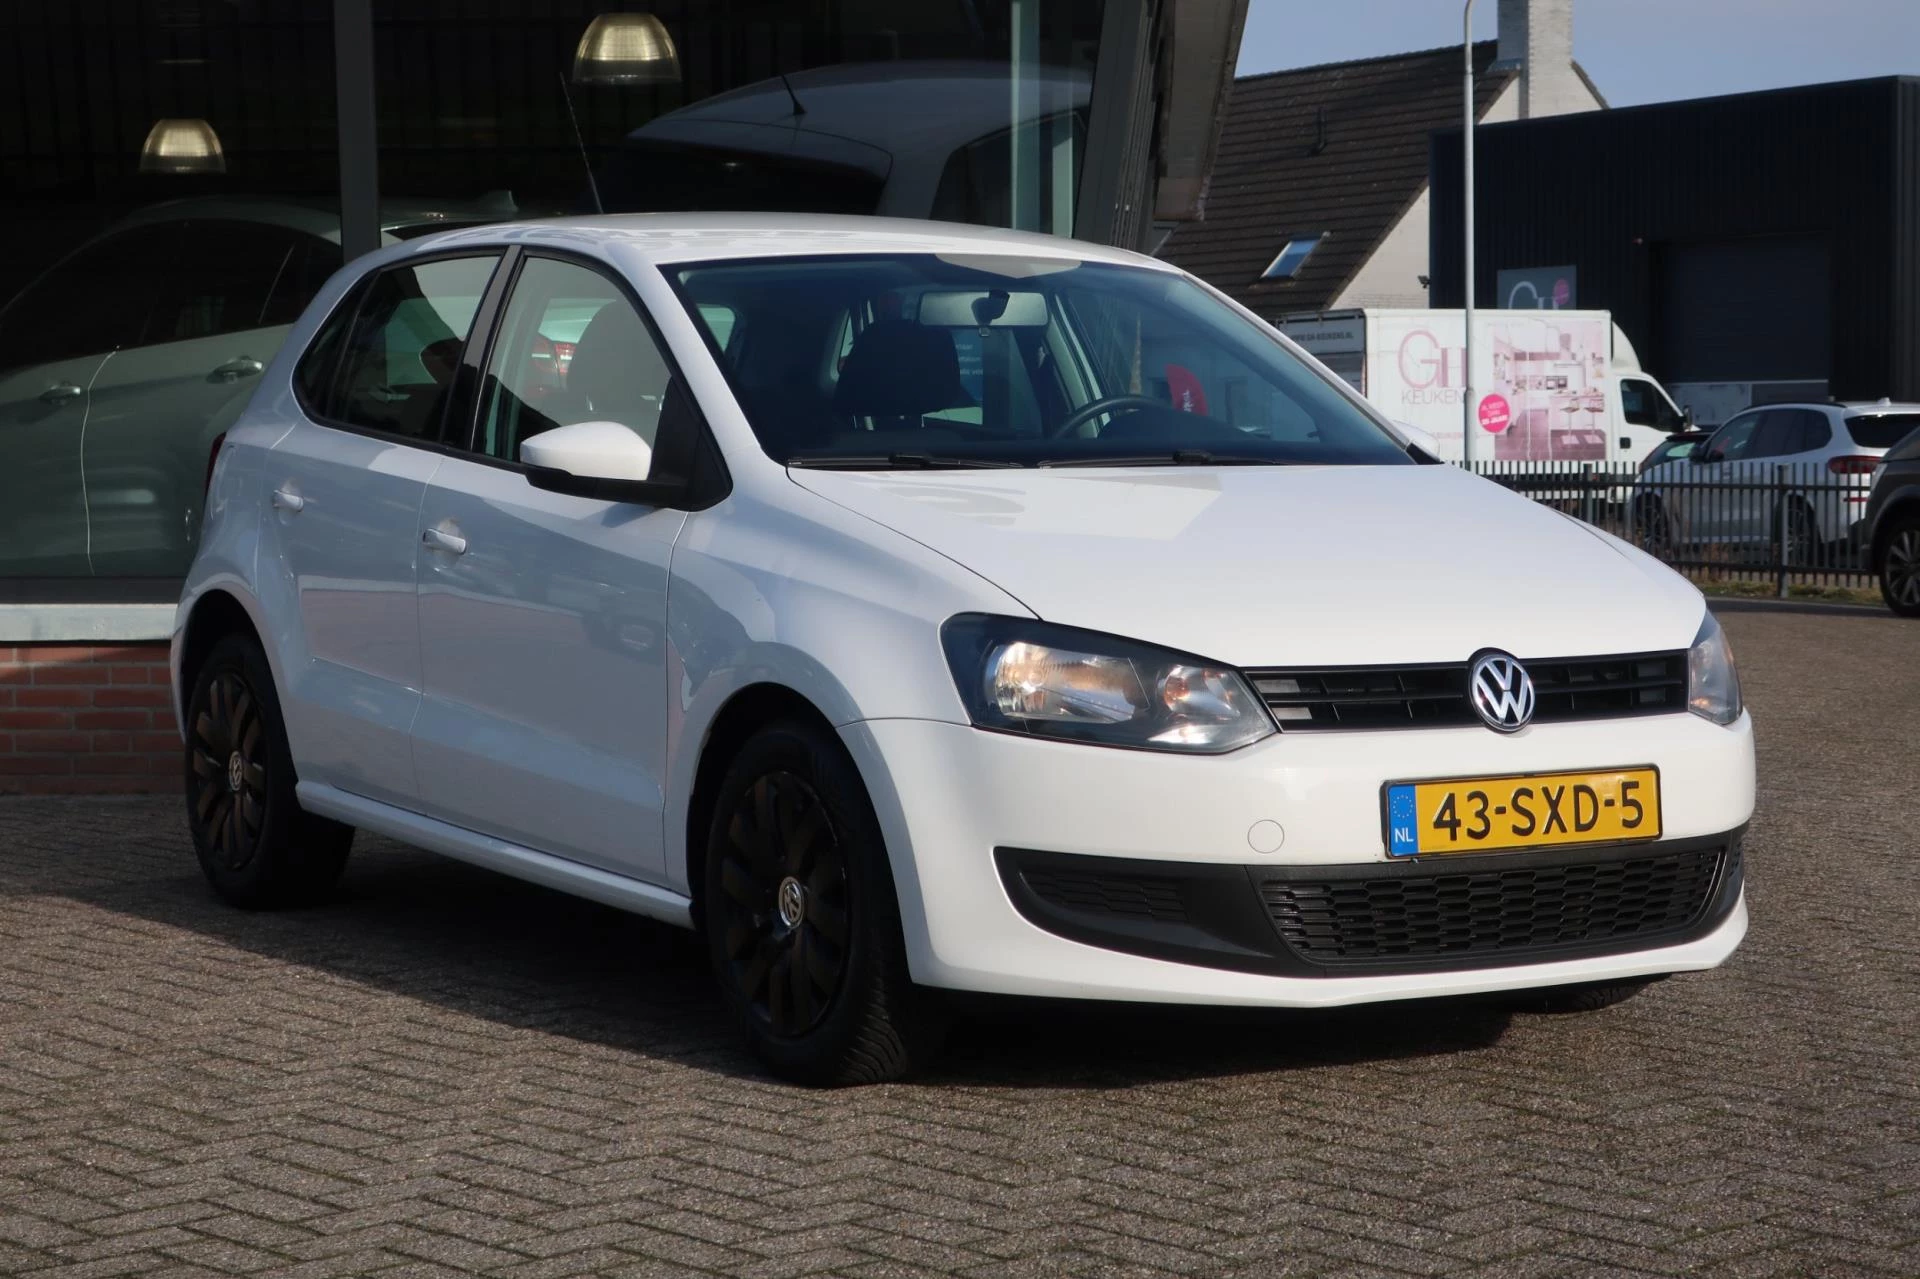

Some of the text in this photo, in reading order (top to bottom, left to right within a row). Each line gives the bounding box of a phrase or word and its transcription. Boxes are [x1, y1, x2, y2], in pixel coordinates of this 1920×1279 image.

[1398, 330, 1468, 389] GH
[1473, 654, 1535, 731] VW
[1395, 827, 1414, 843] NL
[1433, 781, 1644, 841] 43-SXD-5
